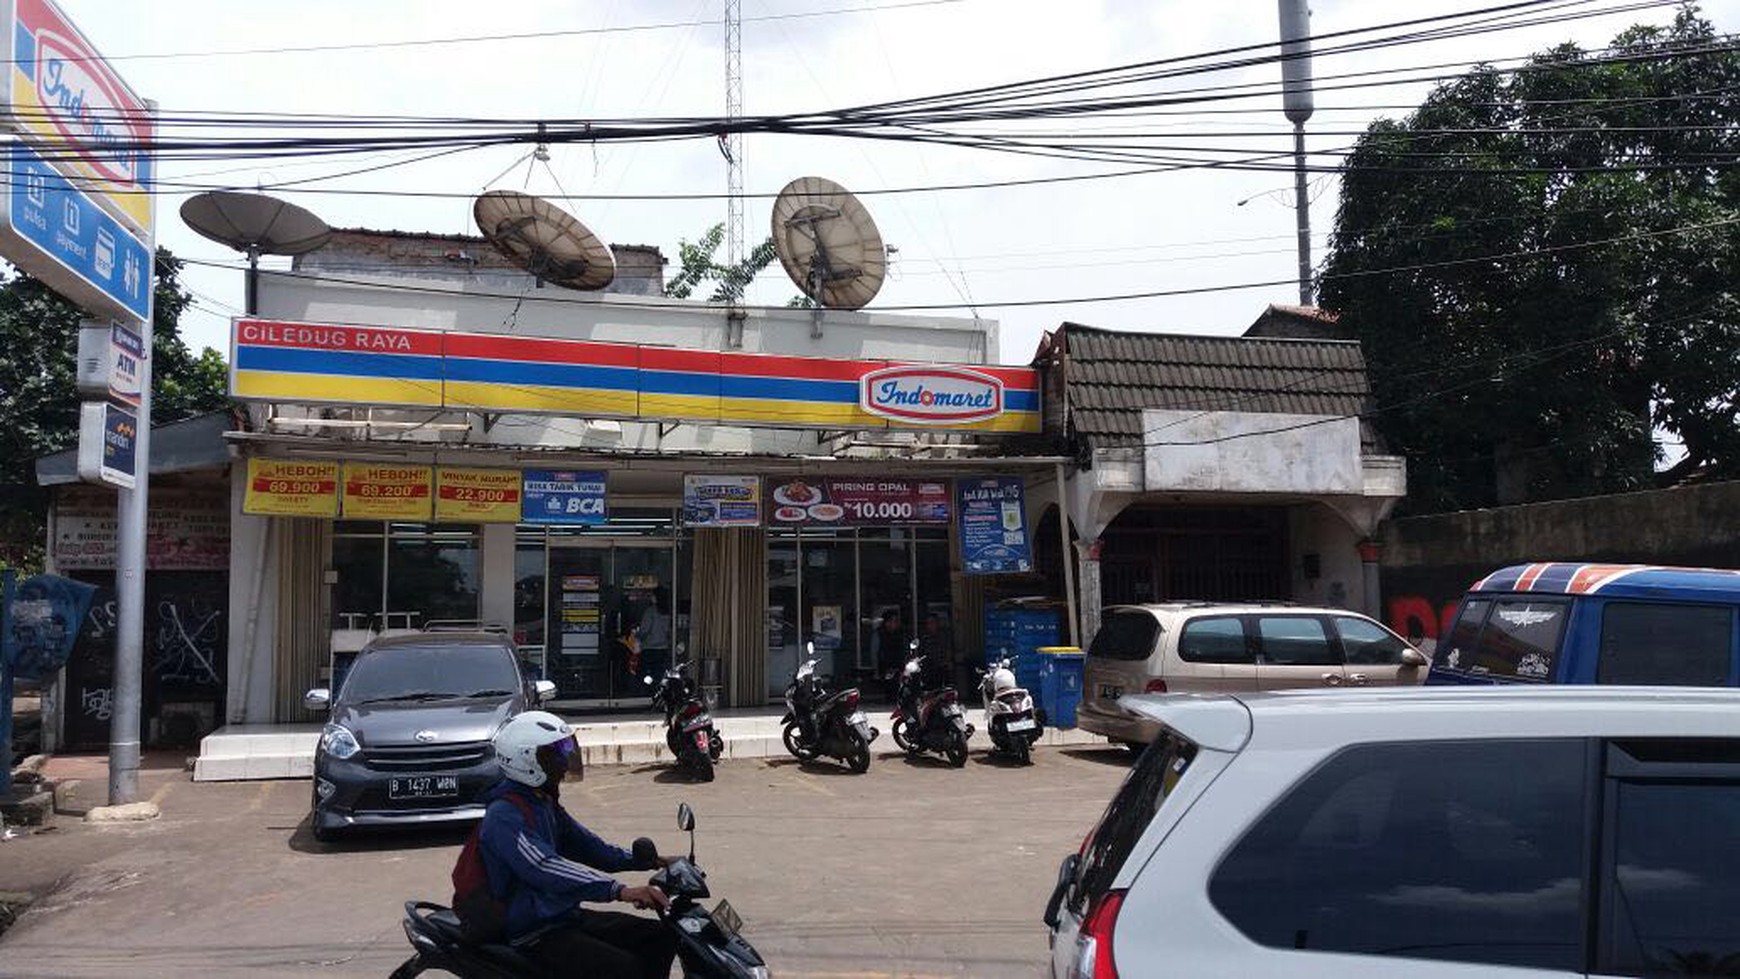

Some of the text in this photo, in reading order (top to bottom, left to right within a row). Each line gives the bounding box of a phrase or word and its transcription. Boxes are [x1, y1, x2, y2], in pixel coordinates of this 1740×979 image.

[43, 58, 130, 172] Indomaet
[243, 326, 411, 350] CILEDUG RAYA
[117, 353, 136, 377] ATM
[876, 380, 993, 408] Indomaret
[269, 481, 320, 494] 69.900
[361, 485, 412, 497] 69.200
[456, 488, 504, 500] 22.900
[833, 483, 875, 491] PIRING
[878, 483, 909, 492] OPAL
[566, 498, 604, 513] BCA
[853, 502, 912, 519] 10.000
[392, 779, 399, 792] B
